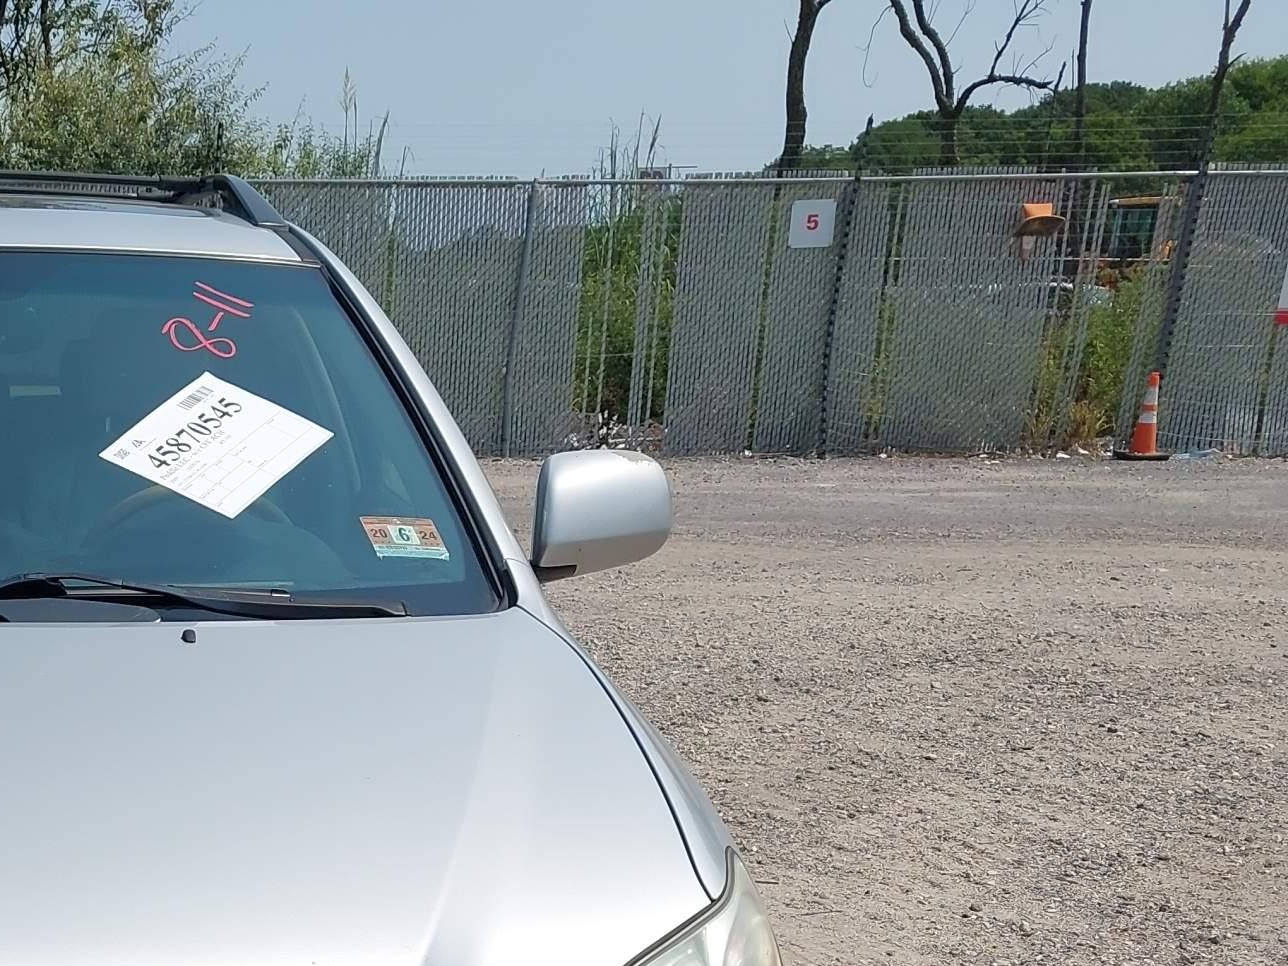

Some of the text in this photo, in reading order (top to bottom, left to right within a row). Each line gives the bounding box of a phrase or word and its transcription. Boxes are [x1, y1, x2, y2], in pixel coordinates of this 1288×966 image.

[806, 214, 819, 231] 5
[147, 397, 242, 469] 45870545
[370, 527, 437, 542] 20 6 24
